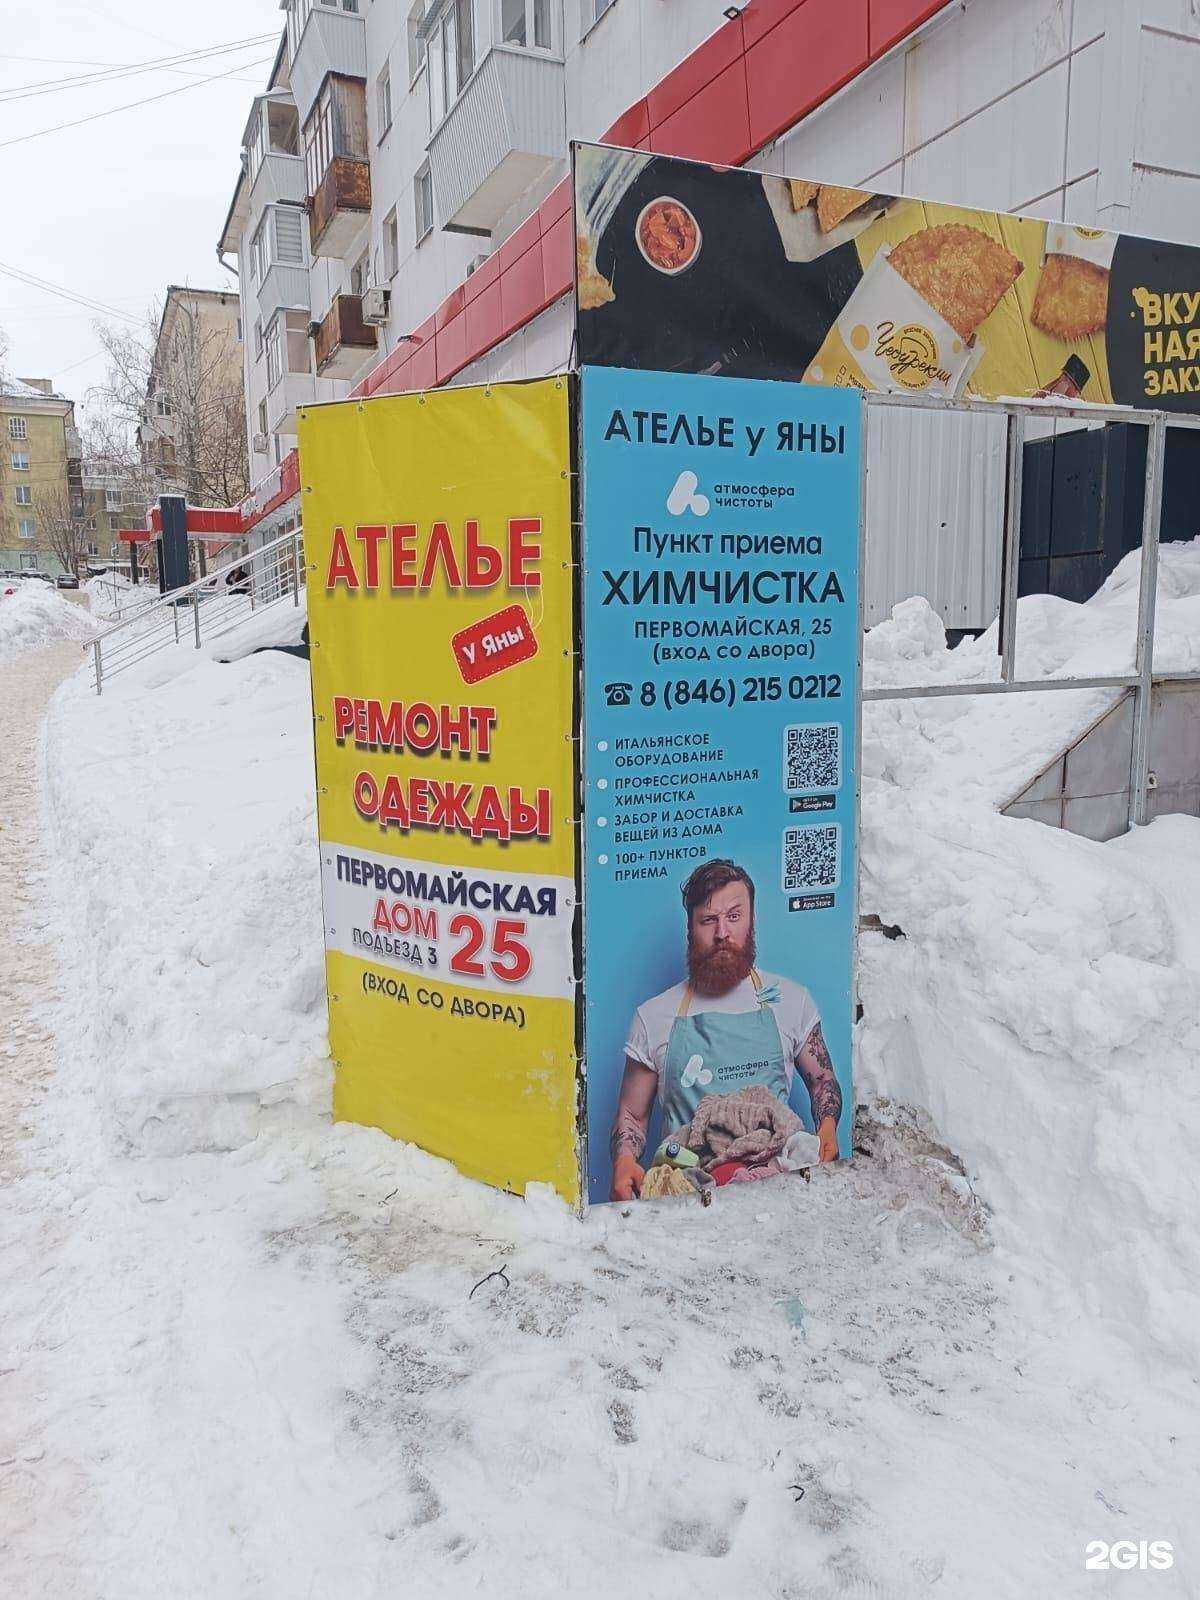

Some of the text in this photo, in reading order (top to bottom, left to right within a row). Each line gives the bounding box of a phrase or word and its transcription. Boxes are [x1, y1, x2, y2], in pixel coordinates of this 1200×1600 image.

[604, 410, 845, 456] АТЕЛЬЕ у ЯНЫ
[714, 483, 795, 497] атмосфера
[715, 497, 773, 509] чистоты
[326, 518, 542, 589] АТЕЛЬЕ
[634, 527, 822, 559] Пункт приема
[602, 571, 845, 606] ХИМЧИСТКА
[634, 616, 832, 640] ПЕРВОМАЙСКАЯ, 25
[481, 626, 525, 657] Яны
[653, 639, 816, 665] (вход со двора)
[640, 674, 842, 710] 8 (846) 215 0212
[334, 696, 496, 754] РЕМОНТ
[615, 733, 710, 751] ИТАЛЬЯНСКОЕ
[615, 750, 724, 768] ОБОРУДОВАНИЕ
[615, 768, 759, 790] ПРОФЕССИОНАЛЬНАЯ
[354, 770, 551, 840] ОДЕЖДЫ
[615, 791, 695, 807] ХИМЧИСТКА
[615, 805, 744, 826] ЗАБОР И ДОСТАВКА
[615, 823, 723, 843] ВЕЩЕЙ ИЗ ДОМА
[616, 846, 706, 864] 100+ ПУНКТОВ
[337, 855, 557, 916] ПЕРВОМАЙСКАЯ
[615, 867, 668, 882] ПРИЕМА
[373, 898, 532, 981] ДОМ 25
[428, 946, 437, 965] 3
[363, 971, 525, 1028] (ВХОД СО ДВОРА)
[718, 1060, 769, 1074] атмосфера
[719, 1071, 755, 1081] чистоты
